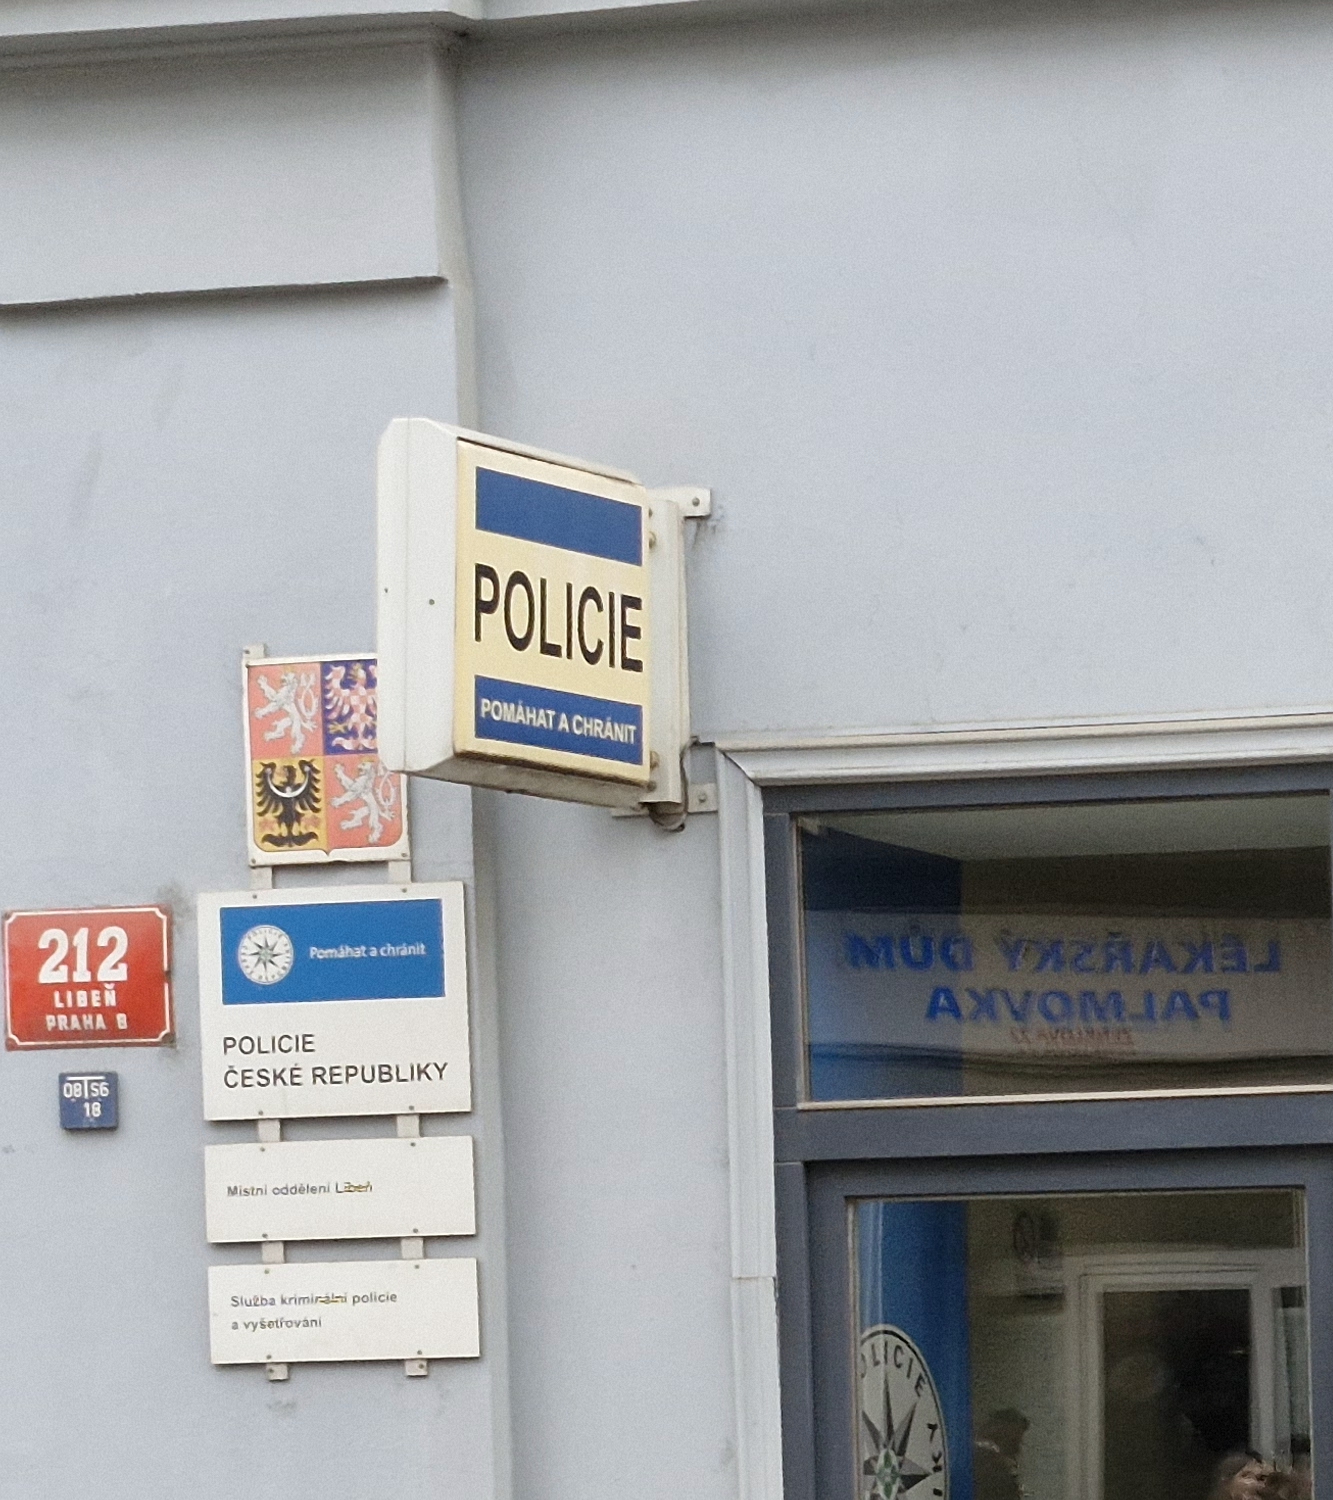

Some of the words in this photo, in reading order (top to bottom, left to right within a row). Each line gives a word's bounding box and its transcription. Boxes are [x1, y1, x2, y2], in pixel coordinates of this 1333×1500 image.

[474, 562, 644, 673] POLICIE
[480, 698, 556, 731] POMÁHAT
[557, 713, 570, 733] A
[572, 714, 637, 745] CHRÁNIT
[37, 925, 129, 984] 212
[309, 944, 368, 960] Pomáhat
[370, 947, 378, 957] a
[380, 941, 427, 957] chránit
[53, 982, 117, 1008] LIBEŇ
[45, 1013, 107, 1031] PRAHA
[115, 1012, 128, 1030] 8
[222, 1033, 316, 1056] POLICIE
[222, 1063, 304, 1089] ČESKÉ
[311, 1061, 449, 1086] REPUBLIKY
[351, 1290, 399, 1306] policie
[231, 1320, 239, 1331] a
